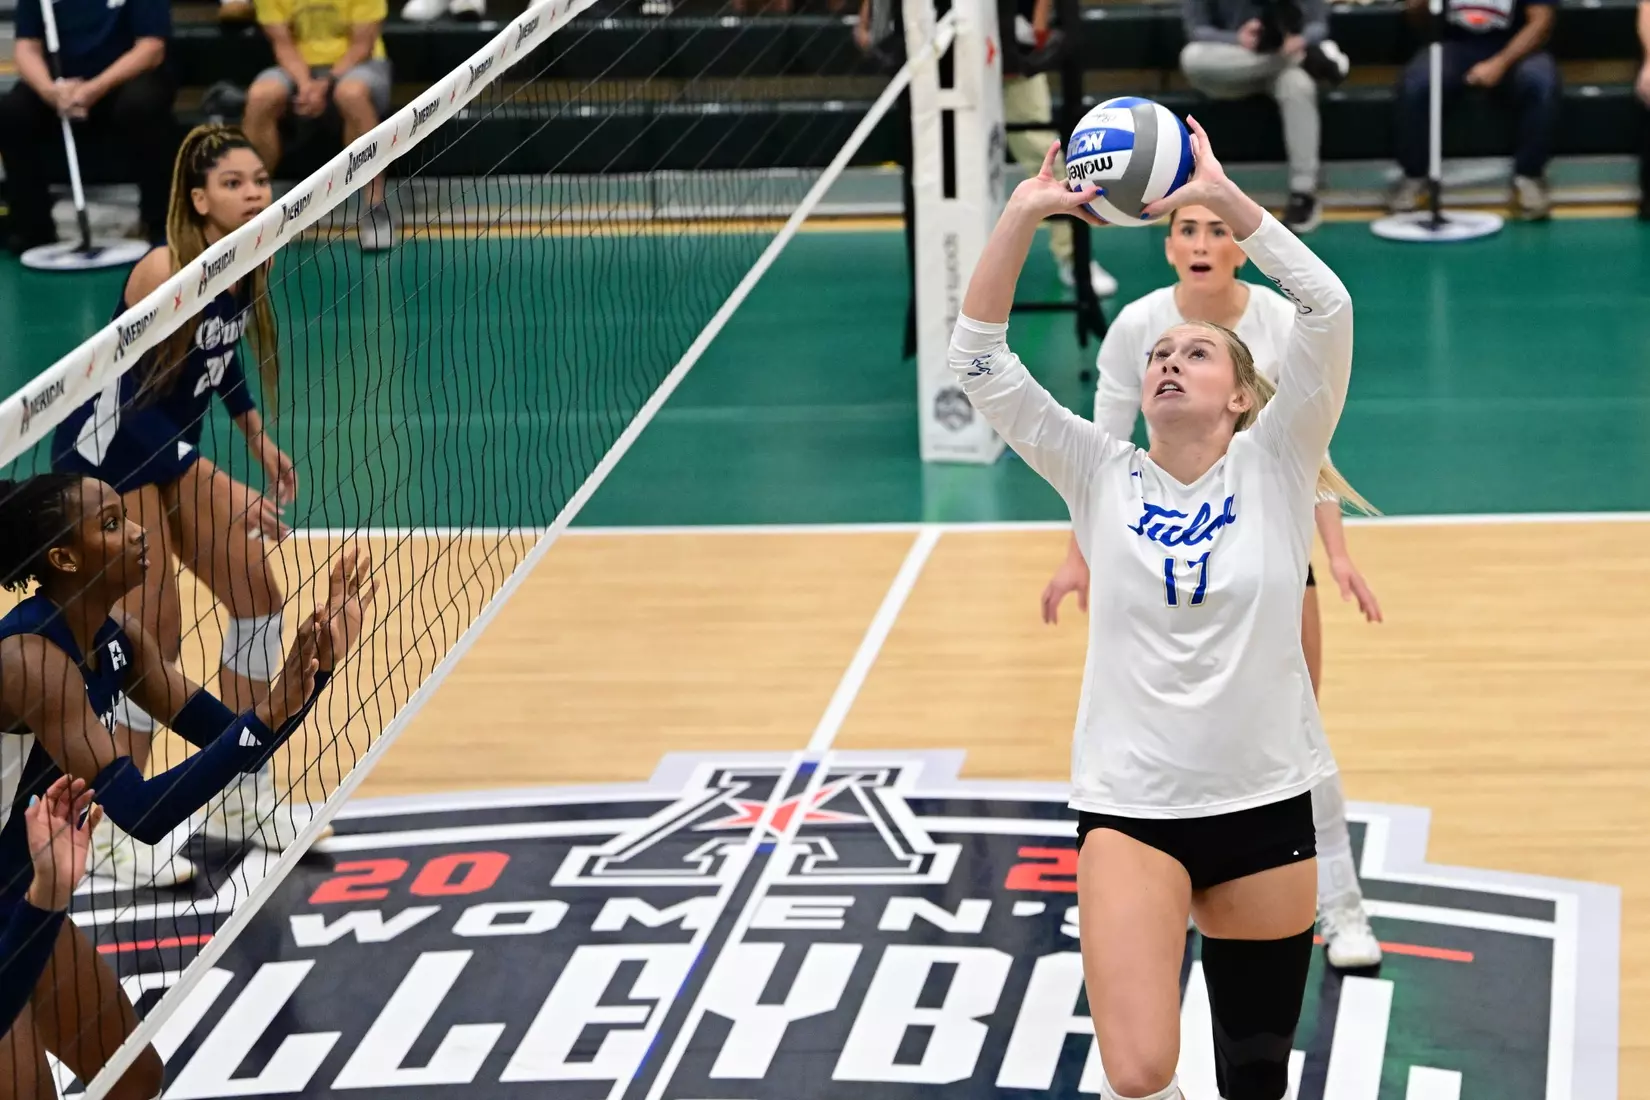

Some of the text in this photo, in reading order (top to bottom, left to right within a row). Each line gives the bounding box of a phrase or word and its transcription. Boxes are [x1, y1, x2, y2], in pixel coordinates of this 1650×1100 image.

[344, 140, 378, 185] AMERICAN
[197, 245, 238, 297] AMERICAN
[113, 307, 159, 363] AMERICAN
[20, 377, 65, 436] AMERICAN
[1162, 551, 1214, 608] 17
[308, 851, 510, 904] 20
[290, 898, 1081, 947] WOMEN'
